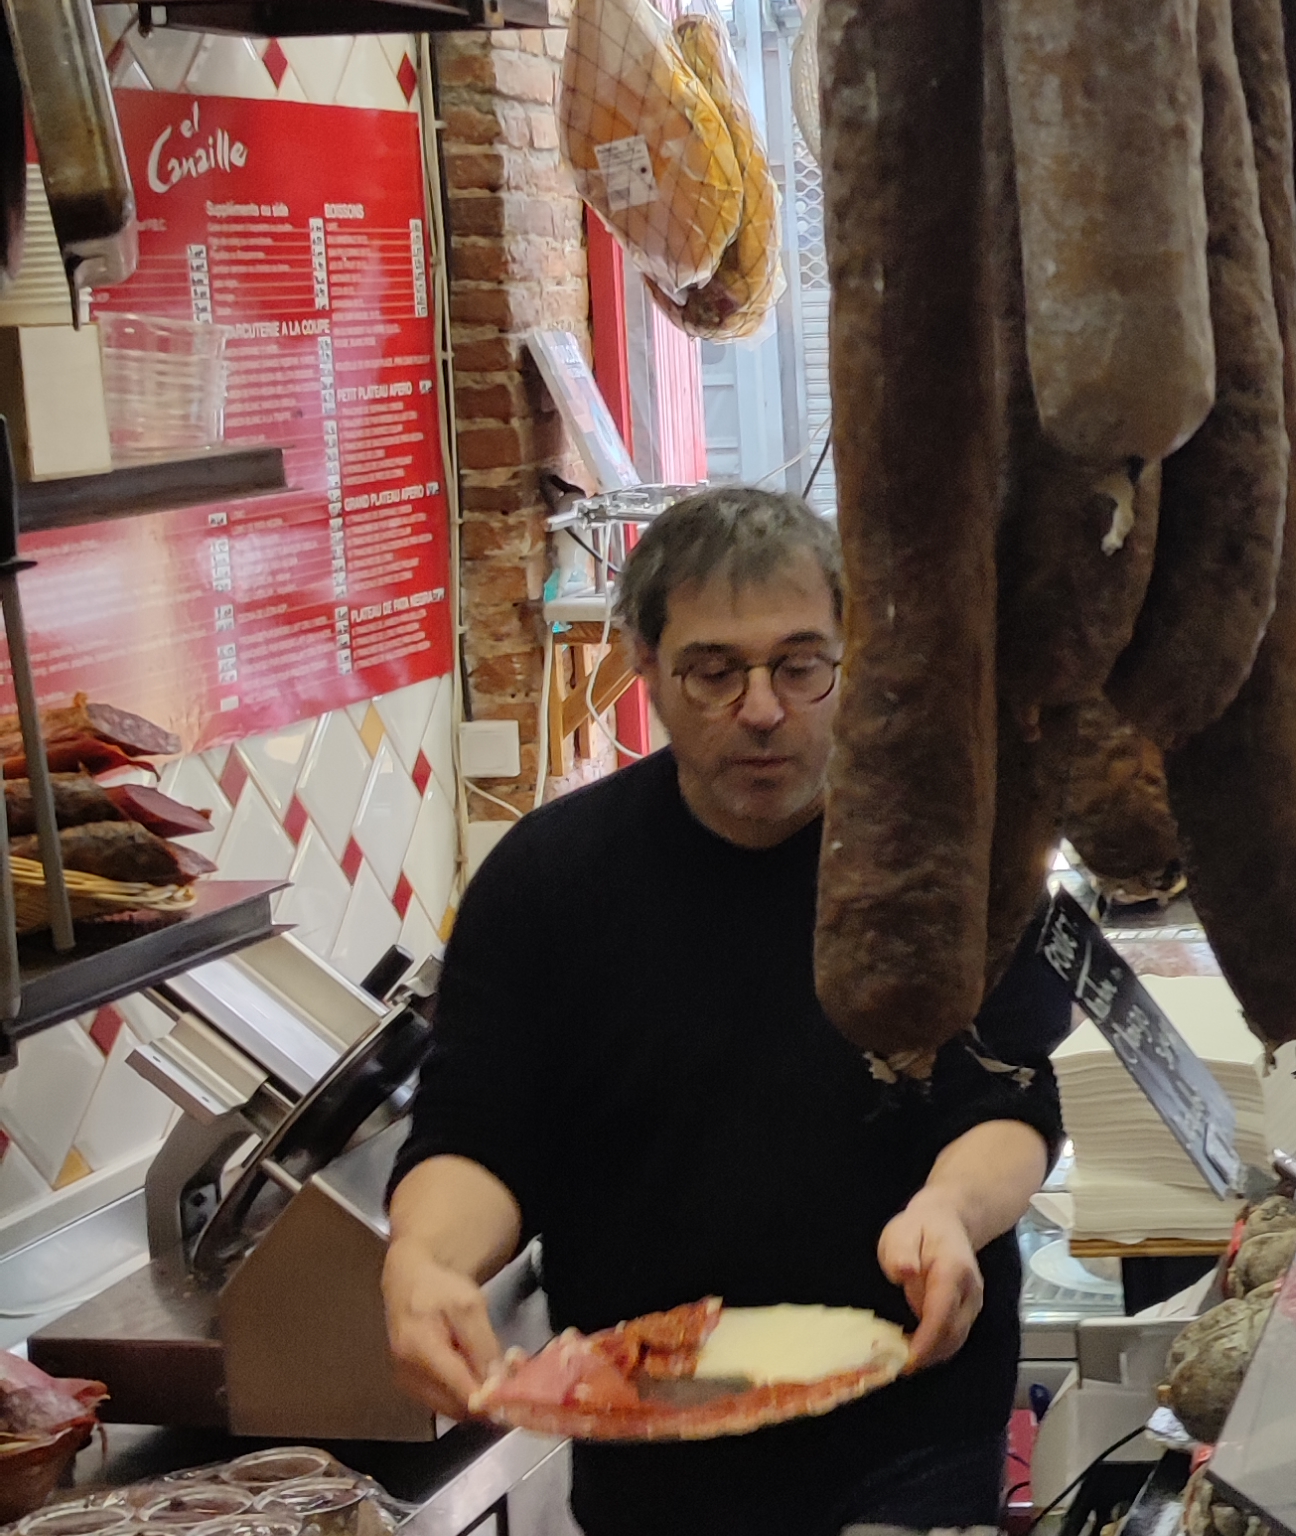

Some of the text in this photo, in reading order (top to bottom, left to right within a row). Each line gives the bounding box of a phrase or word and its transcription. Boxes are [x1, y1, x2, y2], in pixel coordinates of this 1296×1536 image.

[180, 100, 199, 138] el
[147, 124, 248, 193] Canaille
[231, 322, 280, 339] ARCUTERIE
